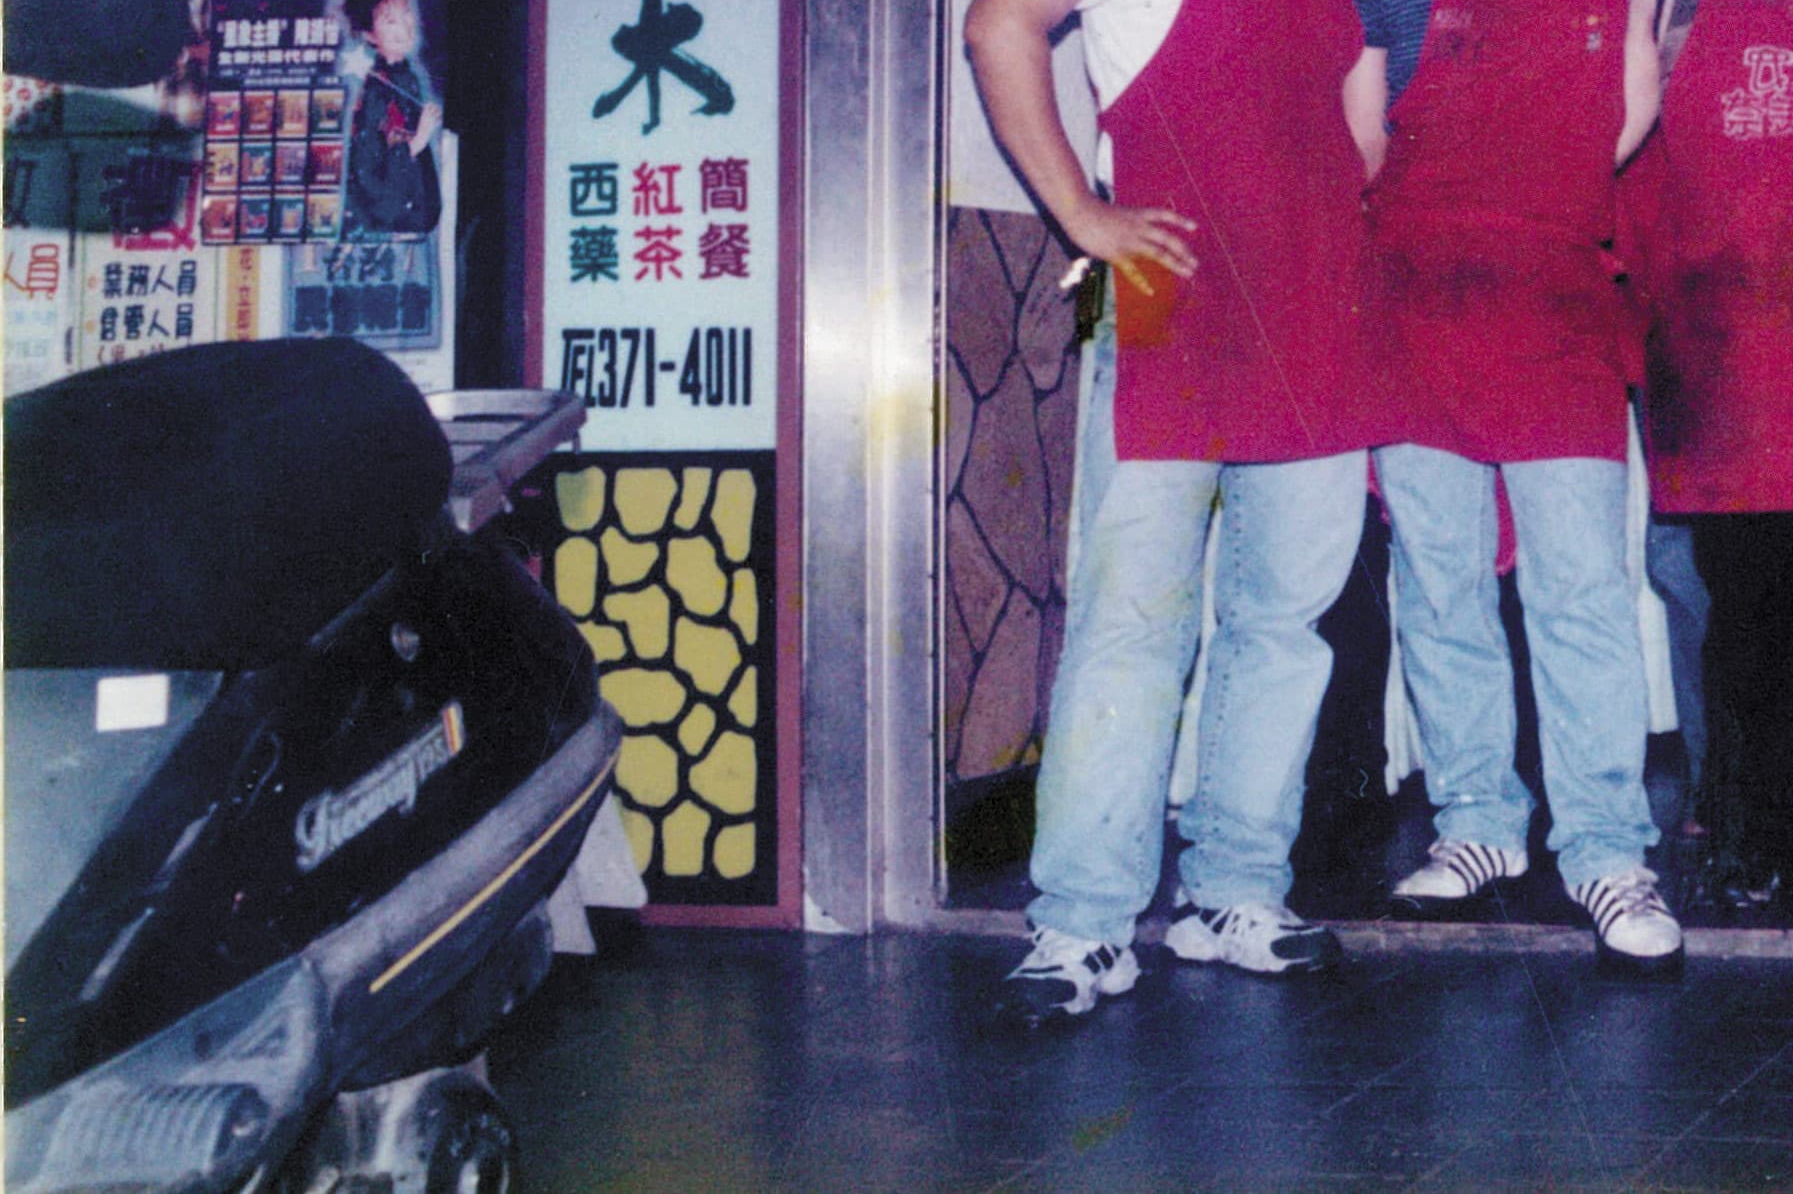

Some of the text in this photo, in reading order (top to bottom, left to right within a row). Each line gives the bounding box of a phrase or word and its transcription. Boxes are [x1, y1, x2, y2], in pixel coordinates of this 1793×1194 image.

[102, 259, 197, 299] 業務人員
[568, 161, 620, 283] 西藥
[631, 160, 683, 283] 紅茶
[697, 156, 753, 281] 簡餐
